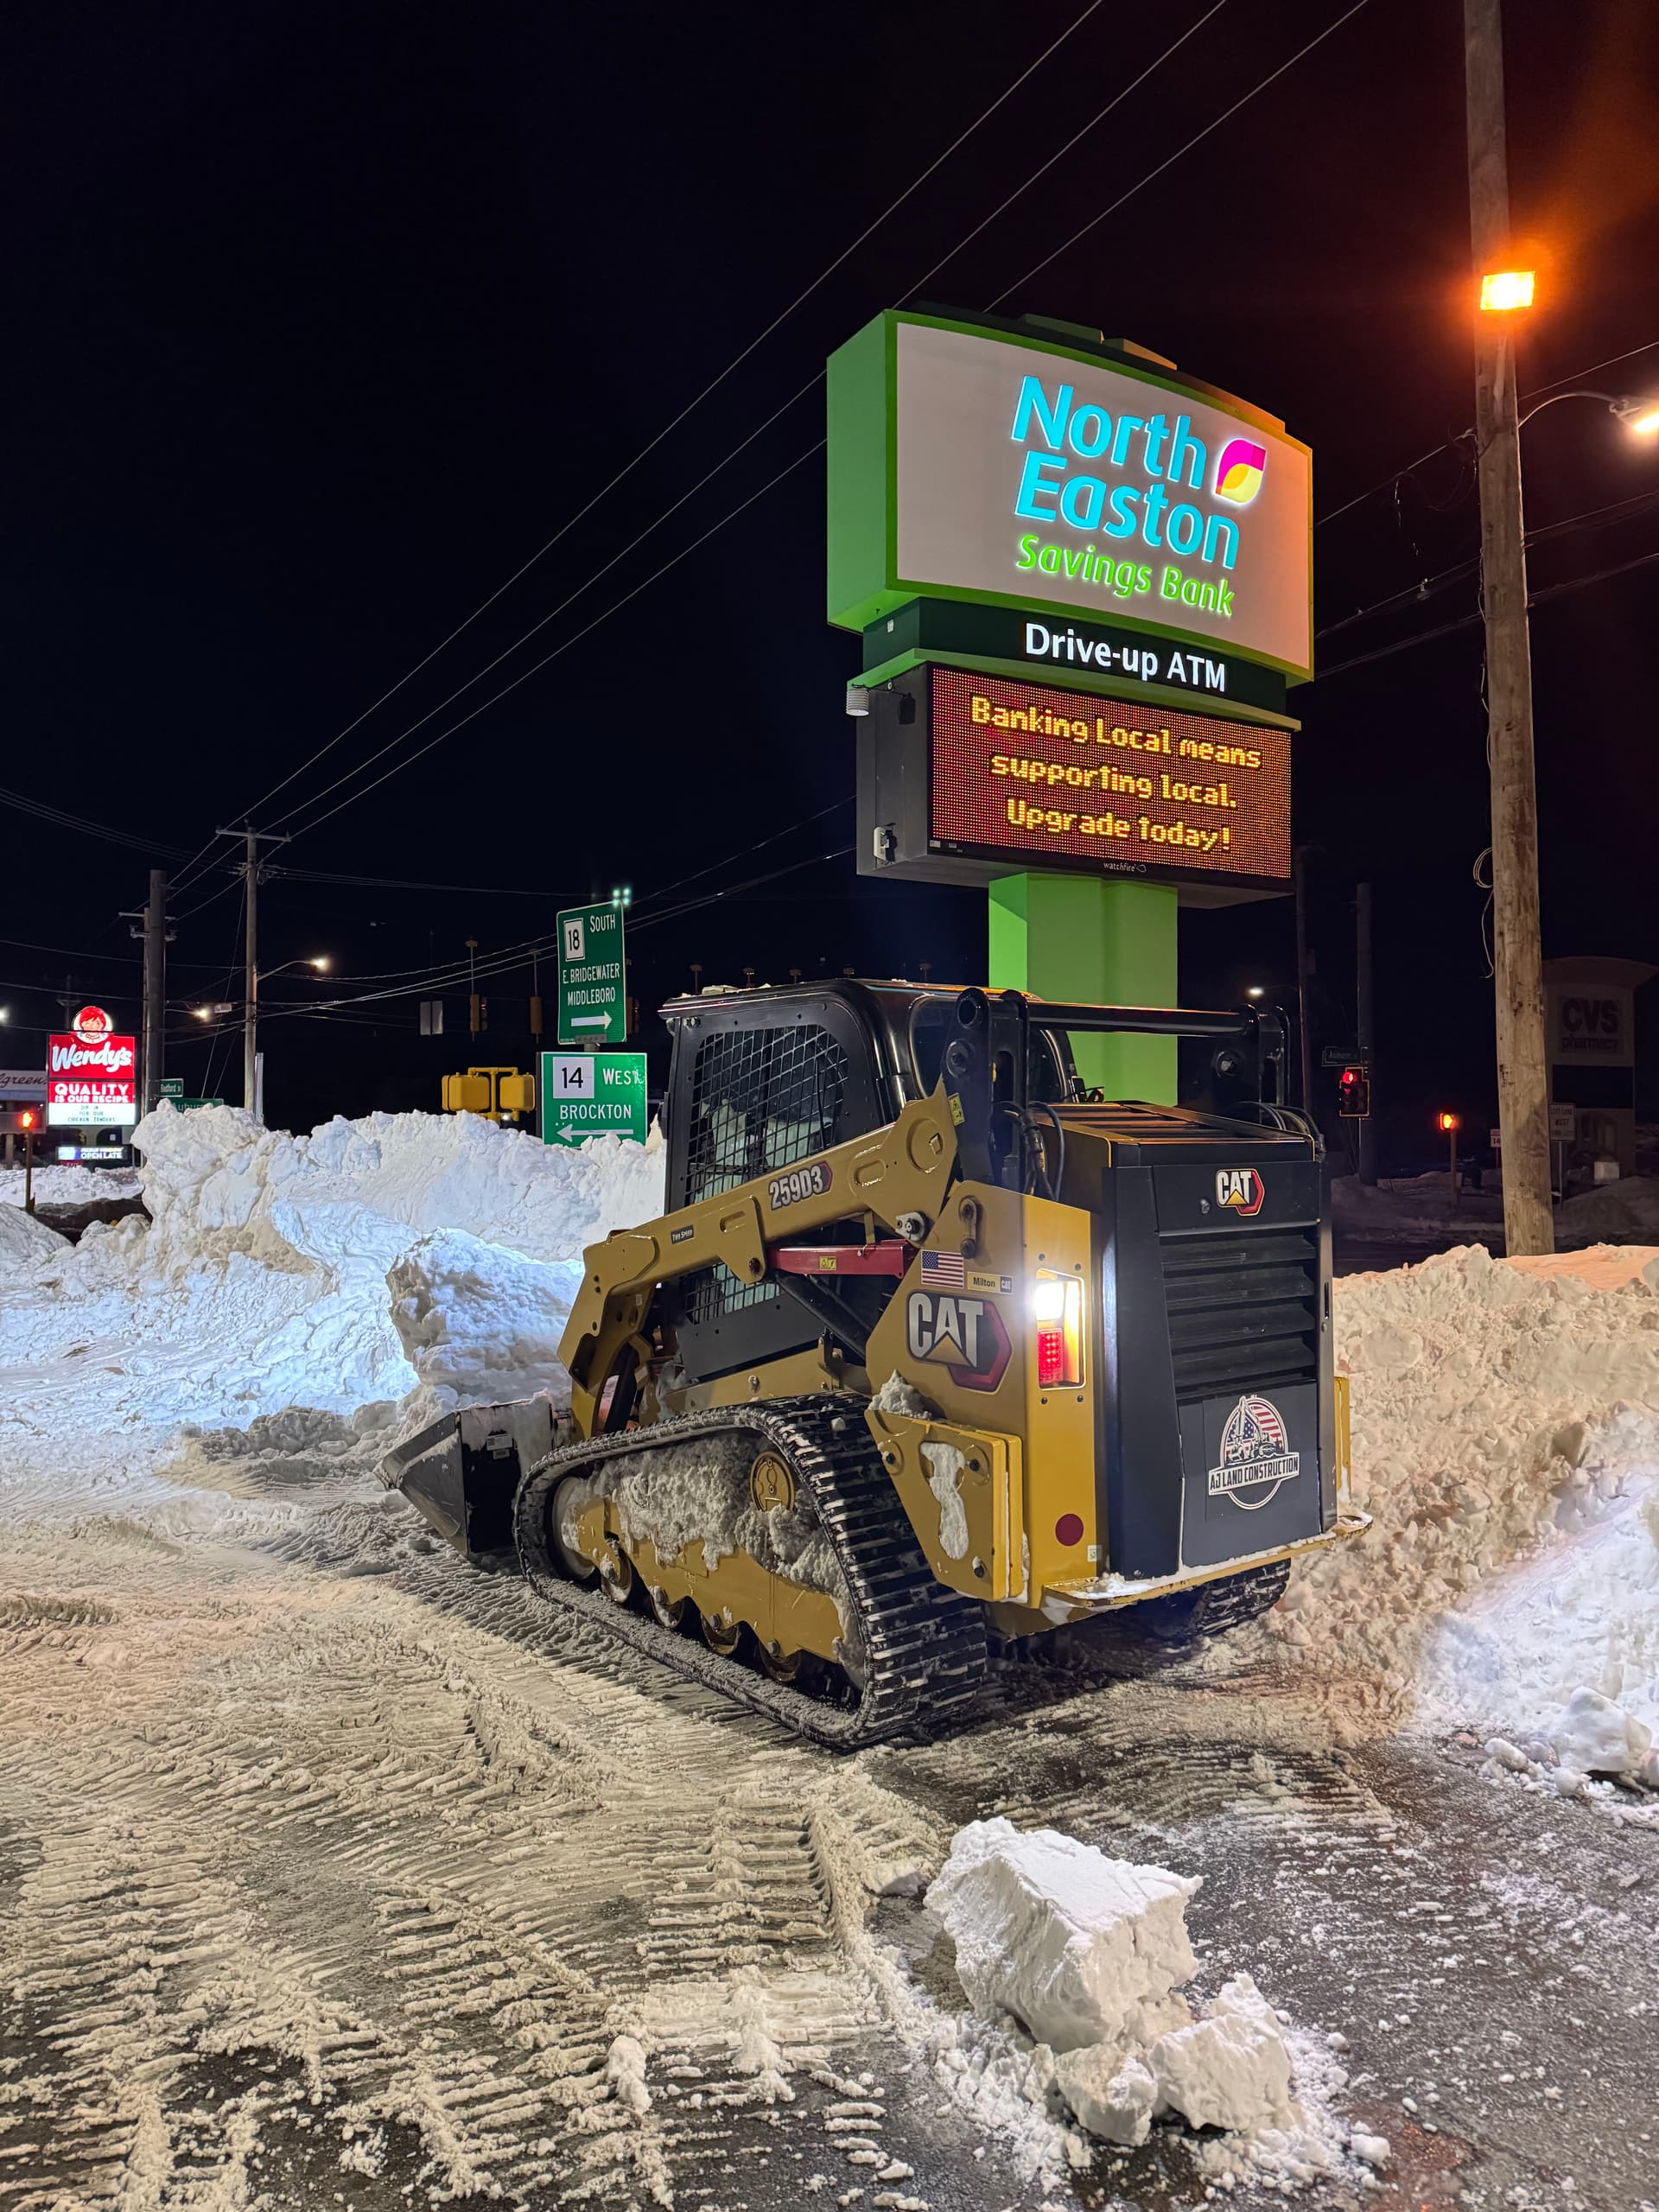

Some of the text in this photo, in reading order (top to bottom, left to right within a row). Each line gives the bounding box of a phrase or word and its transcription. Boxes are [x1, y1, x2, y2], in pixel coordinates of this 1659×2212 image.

[1011, 375, 1207, 489] North
[1014, 449, 1240, 570] Easton
[1015, 534, 1236, 617] Savings Bank
[1025, 622, 1226, 692] Drive-up ATM
[969, 694, 1262, 770] Banking Local means
[990, 754, 1237, 808] supporting local.
[1006, 798, 1232, 852] Upgrade today!
[1103, 862, 1135, 872] watchfire
[568, 914, 616, 951] 18 SOUTH
[570, 963, 620, 983] BRIDGEWATER
[567, 987, 616, 1007] MIDDLEBORO
[1562, 999, 1618, 1033] CVS
[52, 1041, 133, 1072] Wendy's
[1562, 1033, 1618, 1053] pharmacy
[54, 1083, 130, 1096] QUALITY
[562, 1067, 640, 1089] 14 WEST
[54, 1095, 66, 1103] IS
[559, 1104, 632, 1121] BROCKTON
[769, 1165, 823, 1210] 259D3
[1217, 1171, 1252, 1205] CAT
[973, 1276, 995, 1287] Milton
[909, 1293, 984, 1369] CAT
[1210, 1456, 1299, 1491] AJ LAND CONSTRUCTION
